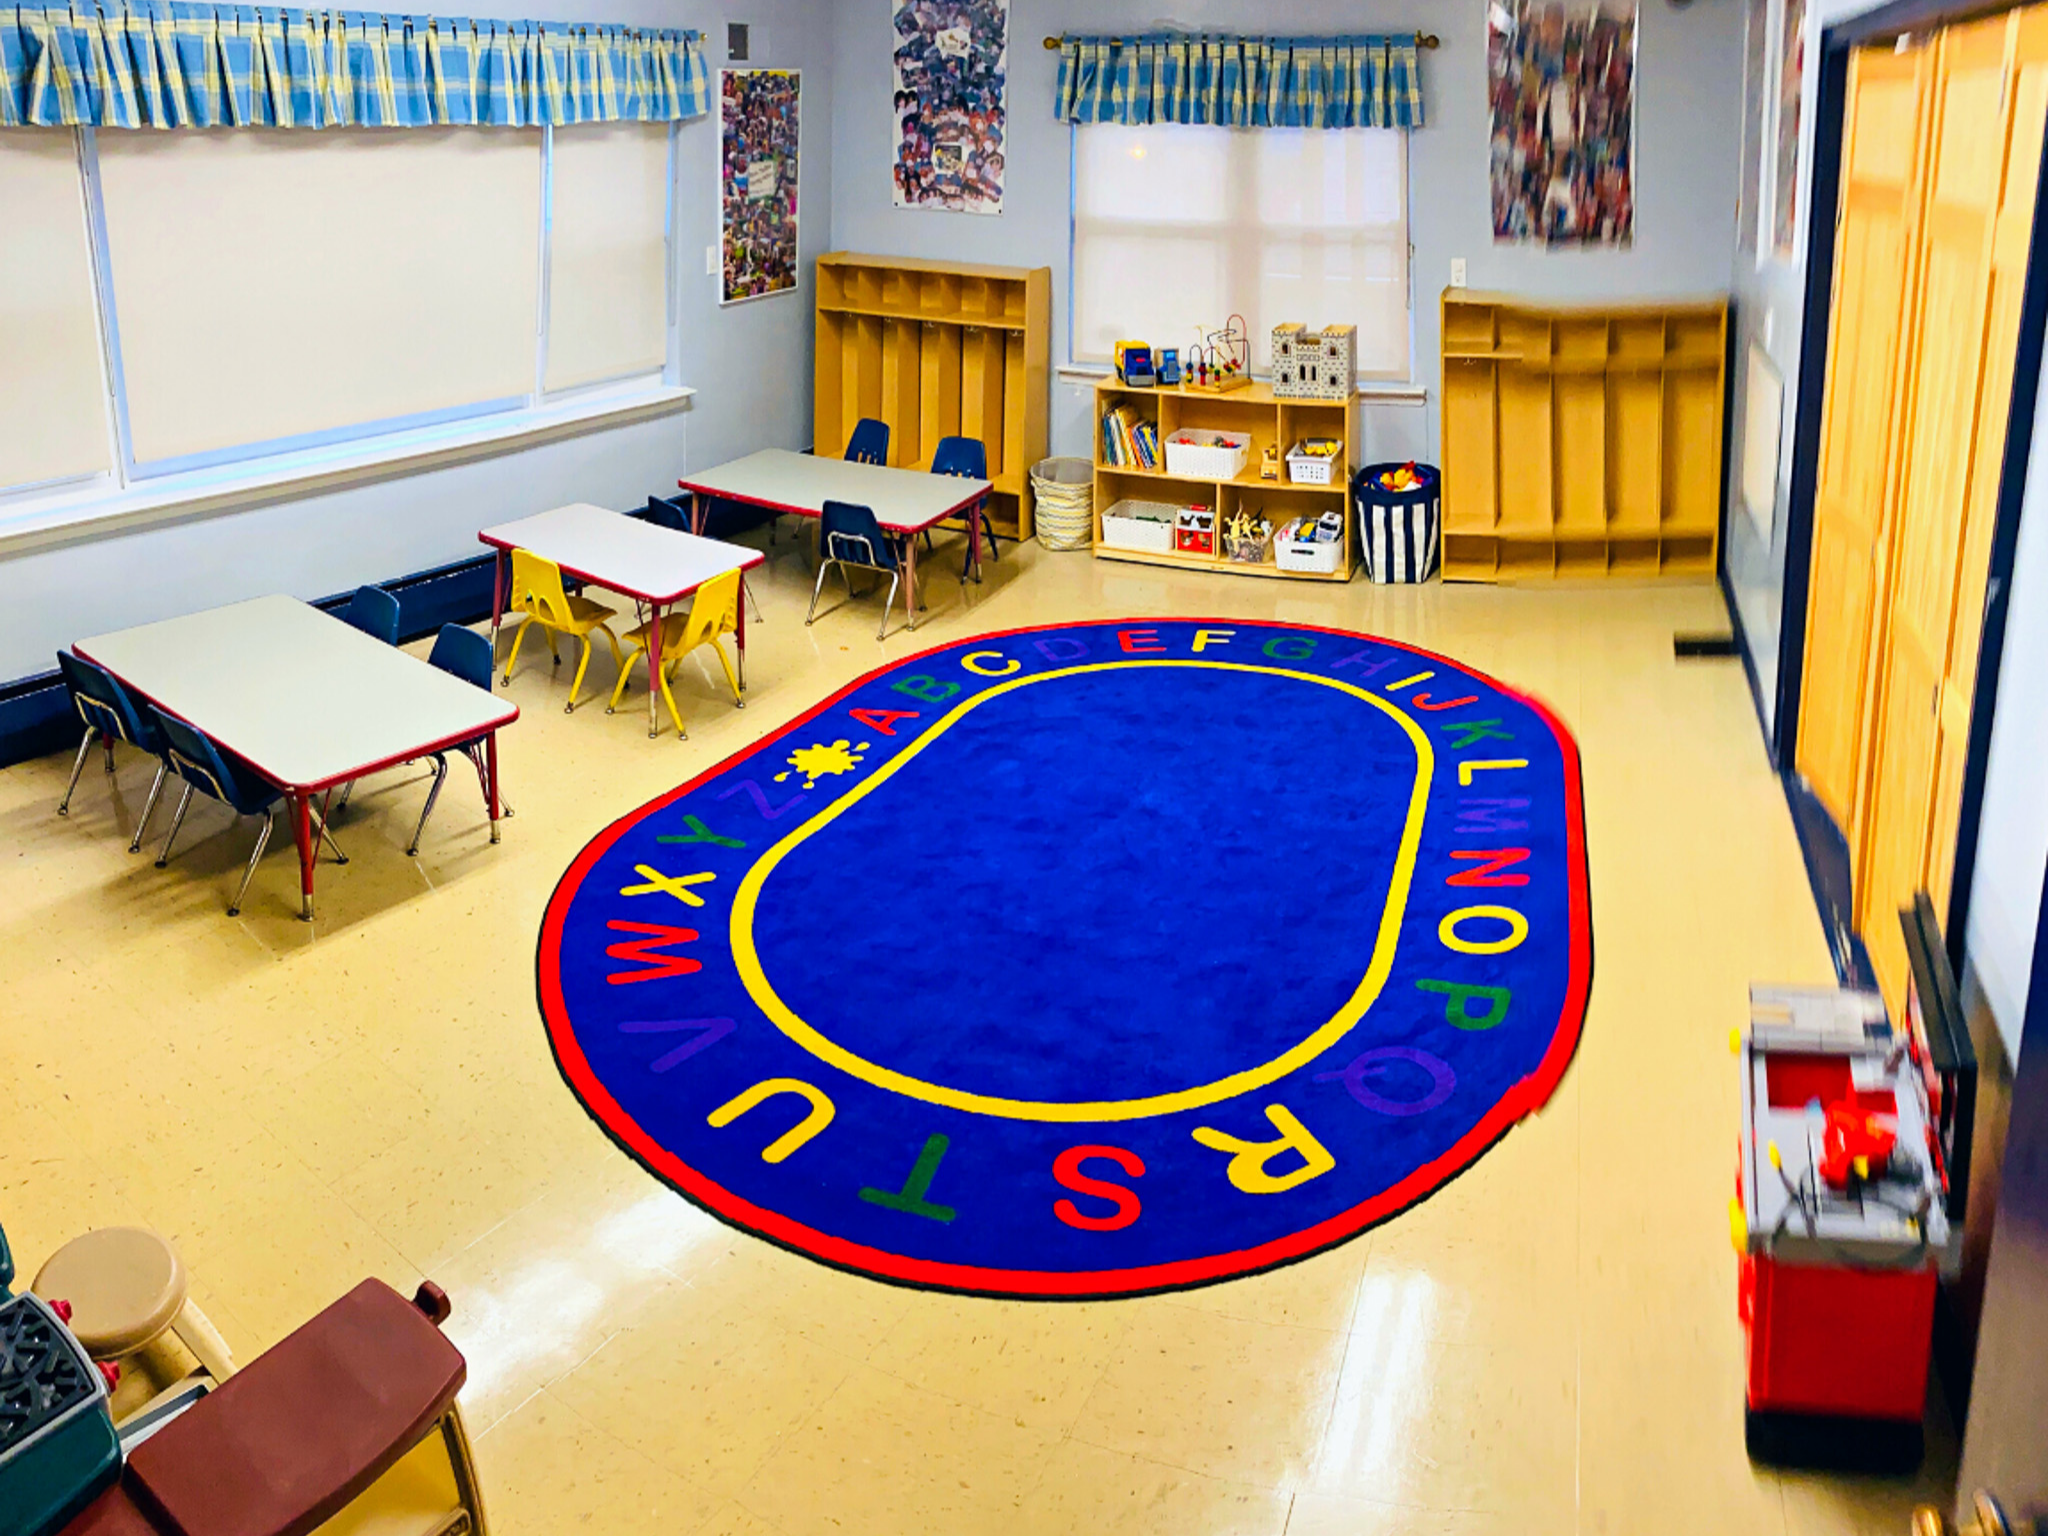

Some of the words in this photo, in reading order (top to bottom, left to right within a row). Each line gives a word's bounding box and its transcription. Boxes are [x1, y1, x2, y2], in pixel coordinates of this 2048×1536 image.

[1032, 638, 1090, 661] D
[1116, 629, 1167, 653] E
[1191, 629, 1236, 652] F
[1261, 636, 1318, 661] G
[960, 650, 1021, 677] C
[1329, 649, 1398, 678] H
[1385, 671, 1436, 691] I
[889, 674, 962, 704] B
[1412, 692, 1479, 711] J
[849, 707, 920, 736] A
[1440, 717, 1516, 750] K
[1458, 758, 1530, 786] L
[718, 779, 806, 820] Z
[1454, 798, 1531, 833] M
[656, 814, 747, 849] Y
[1445, 847, 1531, 887] N
[619, 863, 717, 907] X
[1438, 905, 1529, 955] O
[605, 919, 702, 985] W
[1414, 978, 1512, 1032] P
[618, 1017, 737, 1073] V
[1312, 1046, 1456, 1117] Q
[707, 1077, 836, 1164] U
[1191, 1103, 1336, 1195] R
[858, 1133, 957, 1225] T
[1052, 1144, 1146, 1232] S
